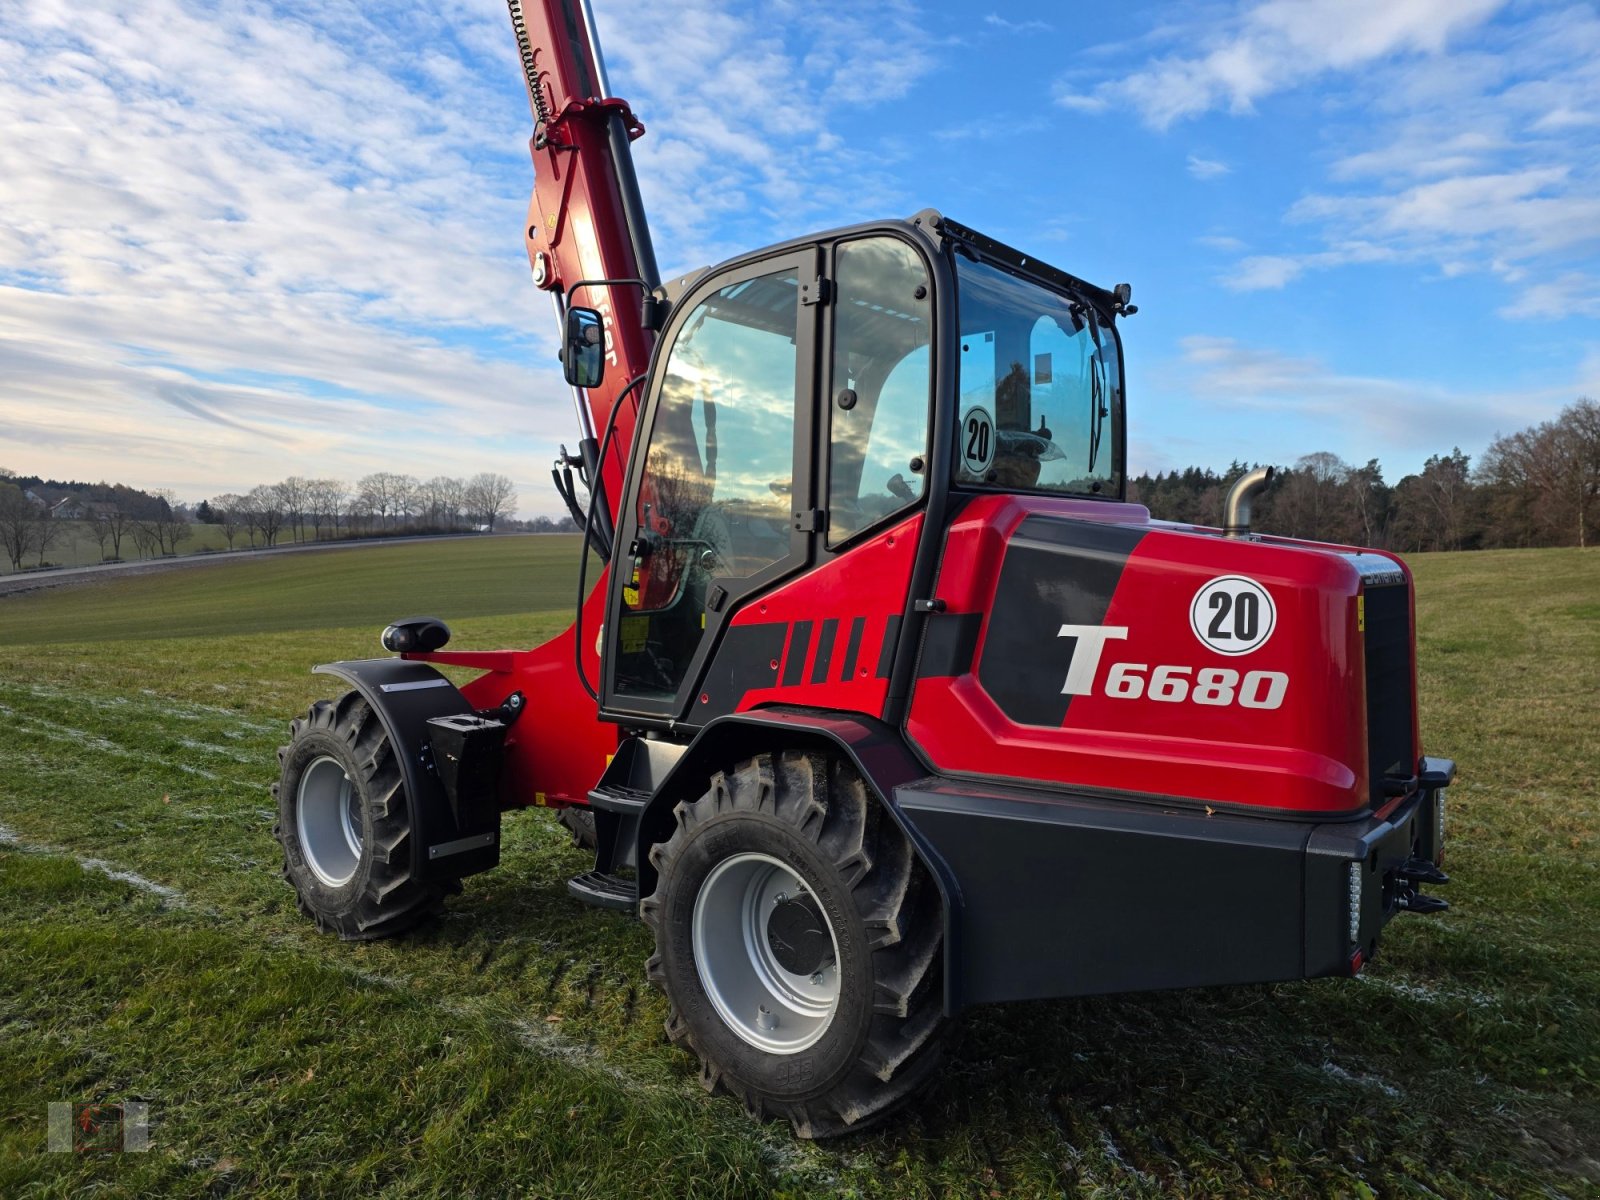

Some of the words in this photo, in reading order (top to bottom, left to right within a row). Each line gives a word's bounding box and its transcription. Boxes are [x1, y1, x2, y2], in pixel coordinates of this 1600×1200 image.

[967, 418, 989, 463] 20
[1208, 591, 1259, 641] 20
[1057, 624, 1289, 710] T6680
